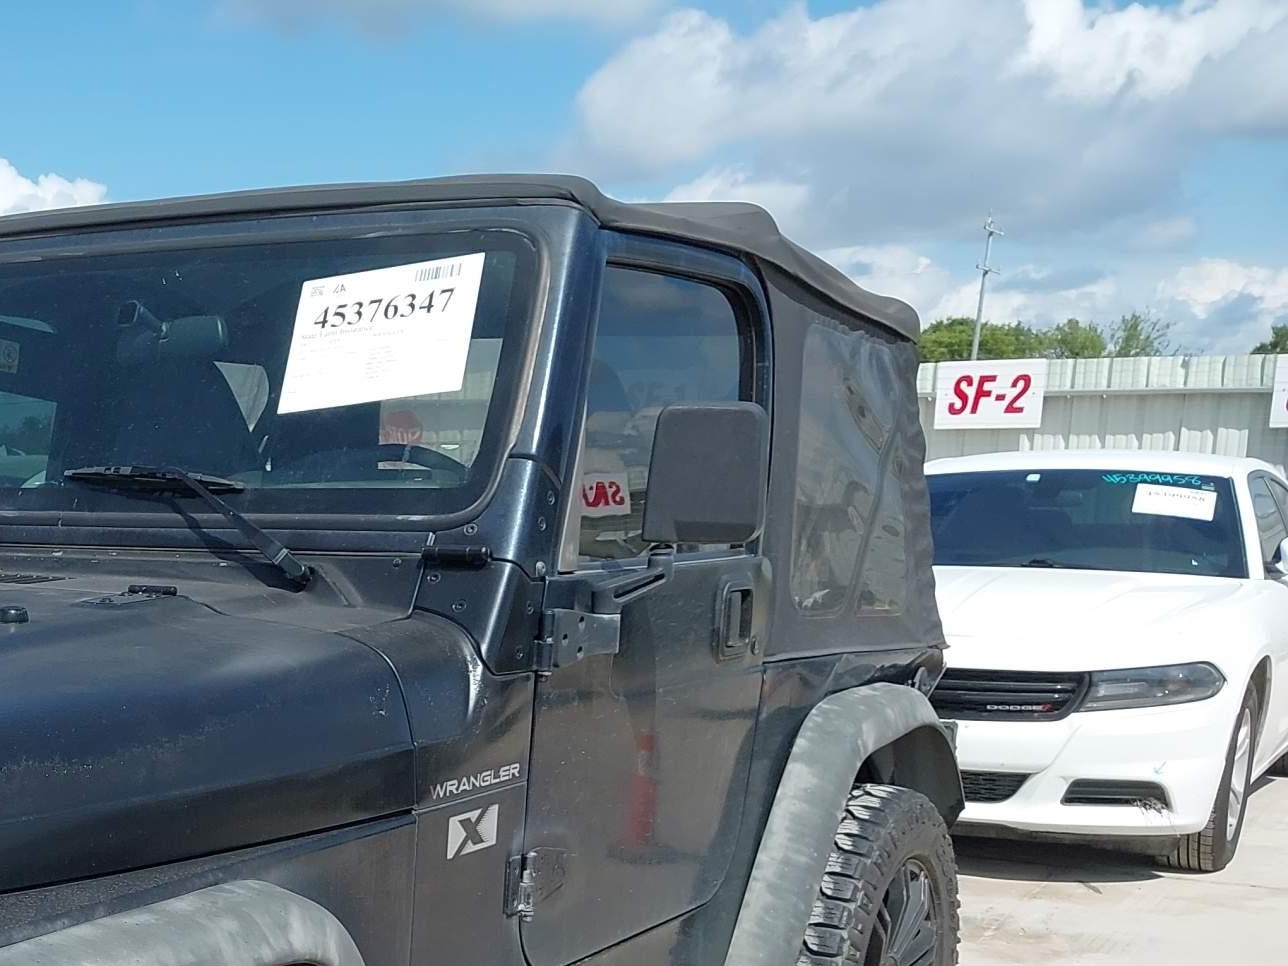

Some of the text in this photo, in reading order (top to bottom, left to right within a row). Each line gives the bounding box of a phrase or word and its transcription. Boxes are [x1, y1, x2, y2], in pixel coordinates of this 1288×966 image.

[313, 287, 456, 329] 45376347
[948, 373, 1032, 416] SF-2
[430, 762, 521, 800] WRANGLER
